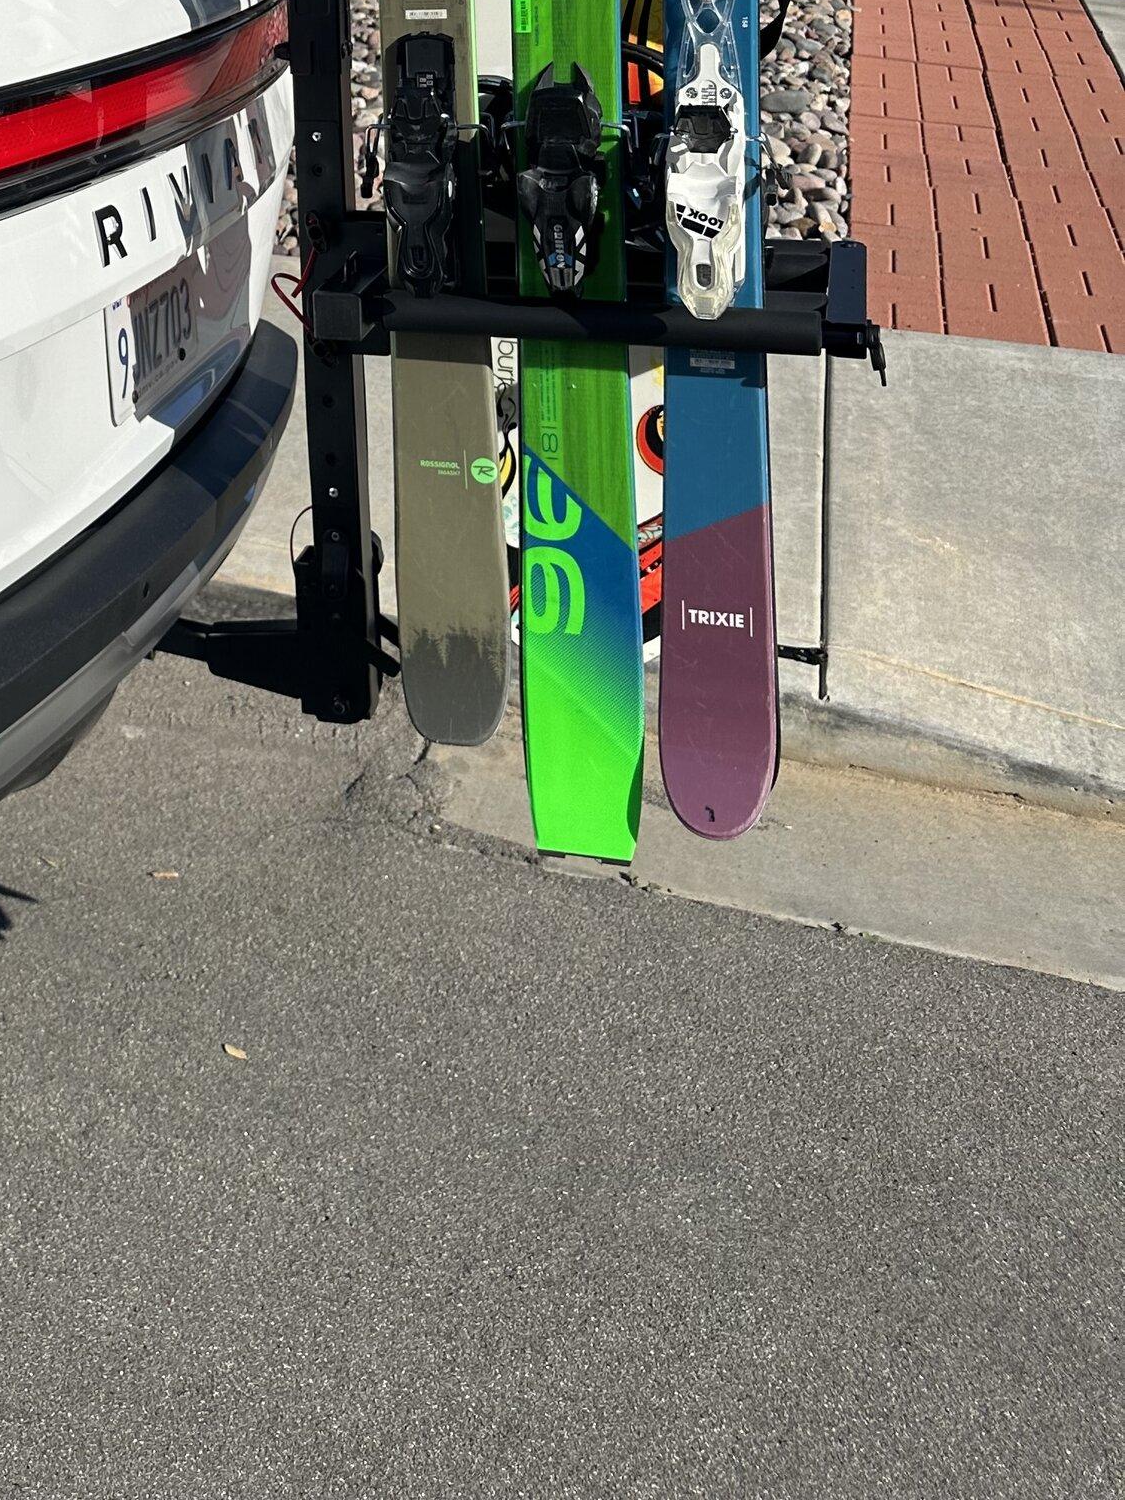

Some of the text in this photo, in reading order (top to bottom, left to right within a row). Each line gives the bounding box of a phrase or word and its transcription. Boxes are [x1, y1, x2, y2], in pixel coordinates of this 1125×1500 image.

[92, 118, 263, 268] RIVIAN
[688, 206, 724, 230] LOOK
[687, 609, 745, 629] TRIXIE
